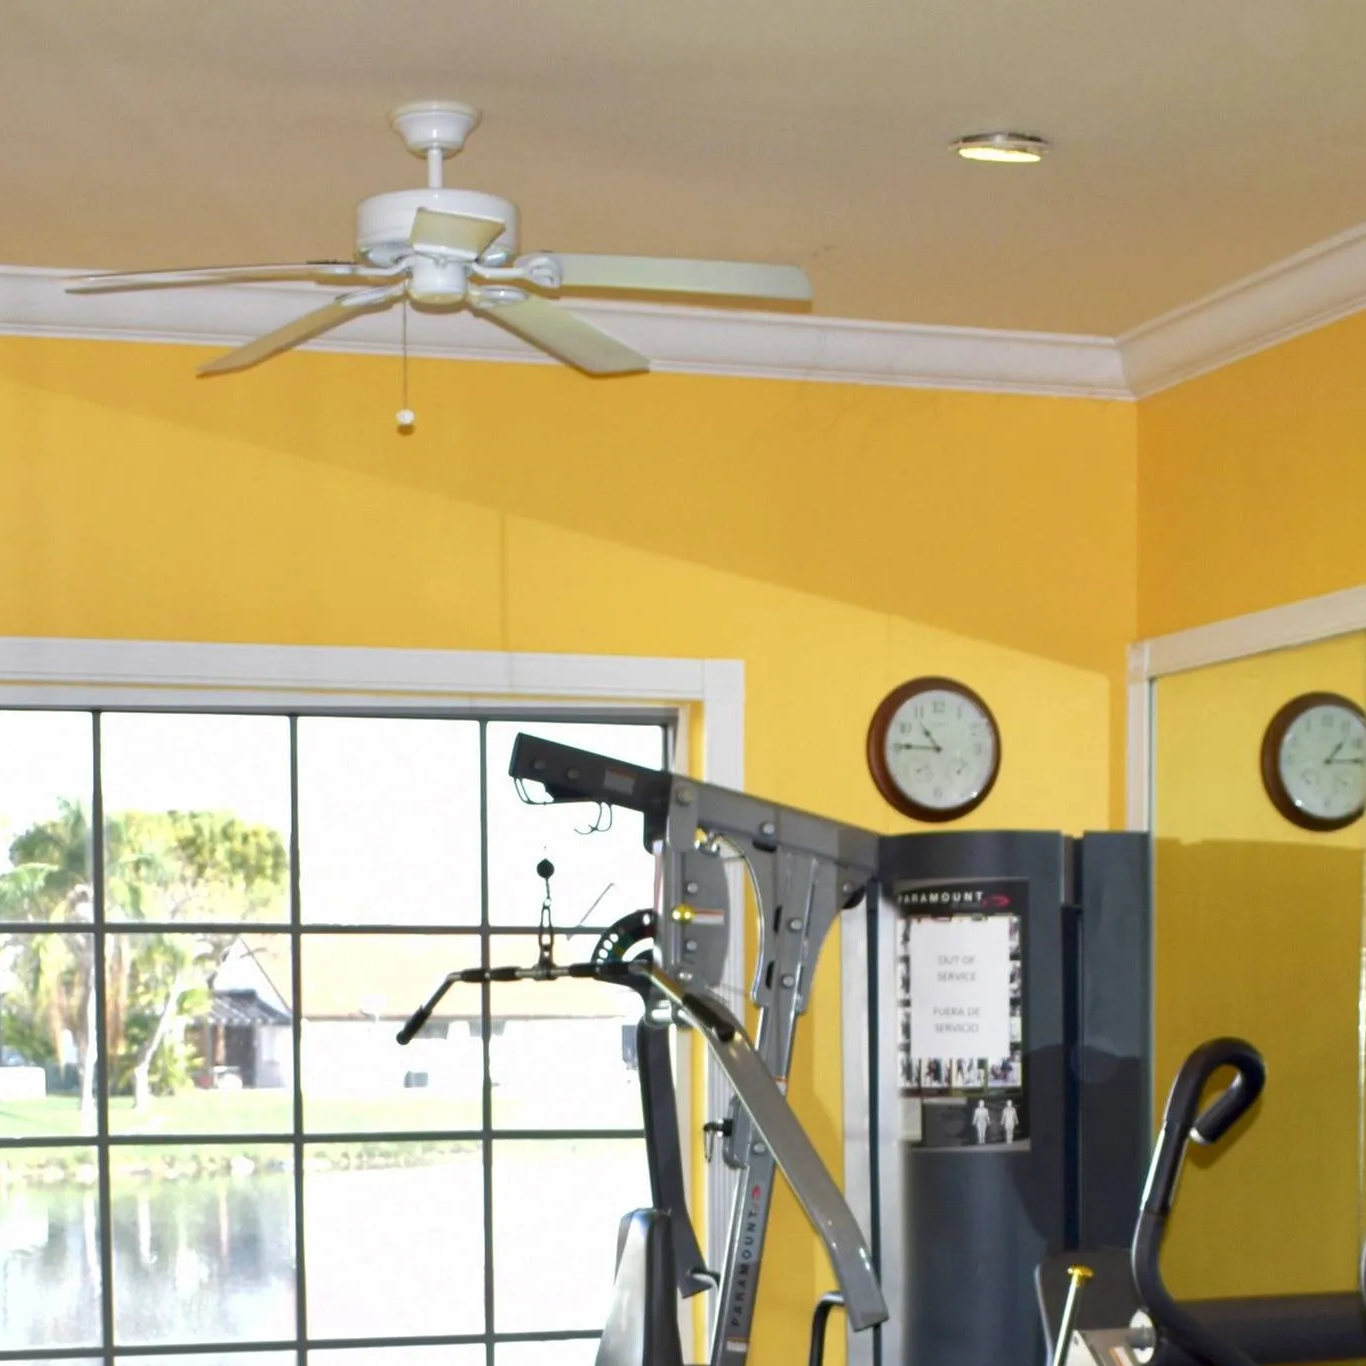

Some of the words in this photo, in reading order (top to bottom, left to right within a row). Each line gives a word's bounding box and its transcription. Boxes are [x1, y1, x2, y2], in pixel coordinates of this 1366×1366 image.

[897, 891, 984, 904] PARAMOUNT
[939, 955, 959, 966] OUT
[961, 955, 976, 966] OF
[937, 972, 977, 982] SERVICE
[933, 1007, 964, 1018] FUERA
[967, 1007, 980, 1018] DE
[934, 1023, 979, 1034] SERVICIO
[731, 1209, 757, 1328] PARAMOUNT
